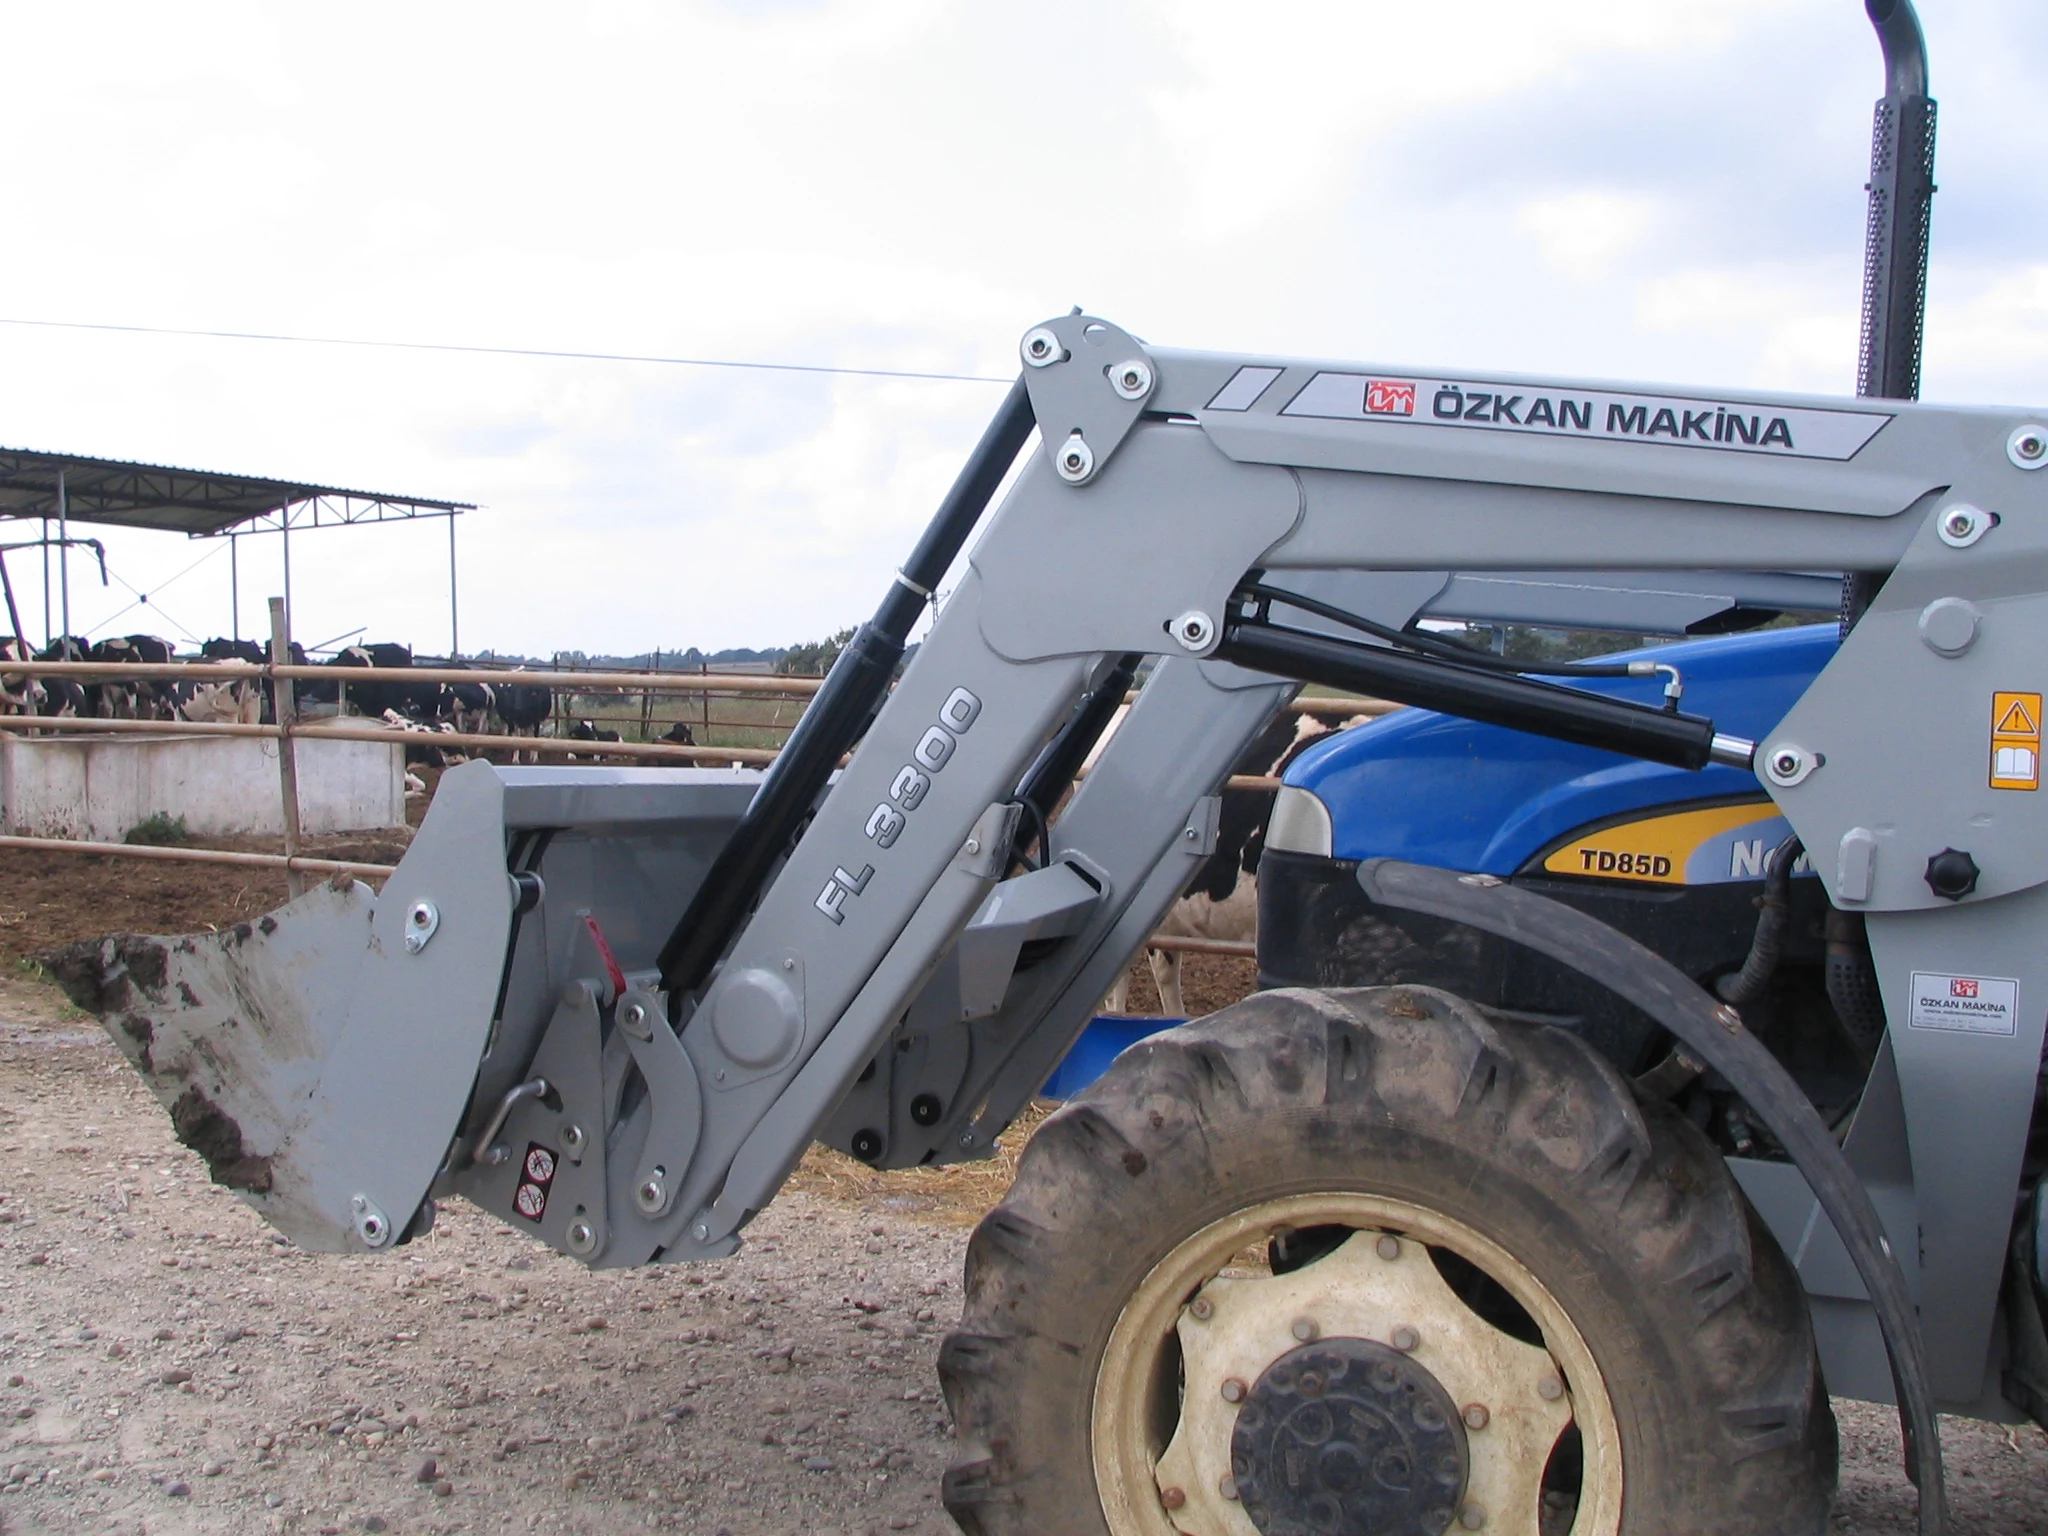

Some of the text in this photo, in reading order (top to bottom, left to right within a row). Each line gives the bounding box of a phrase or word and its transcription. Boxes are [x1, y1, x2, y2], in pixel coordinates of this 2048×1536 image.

[1433, 384, 1591, 430] ÖZKAN
[813, 686, 983, 926] FL 3300
[1579, 849, 1672, 877] TD85D
